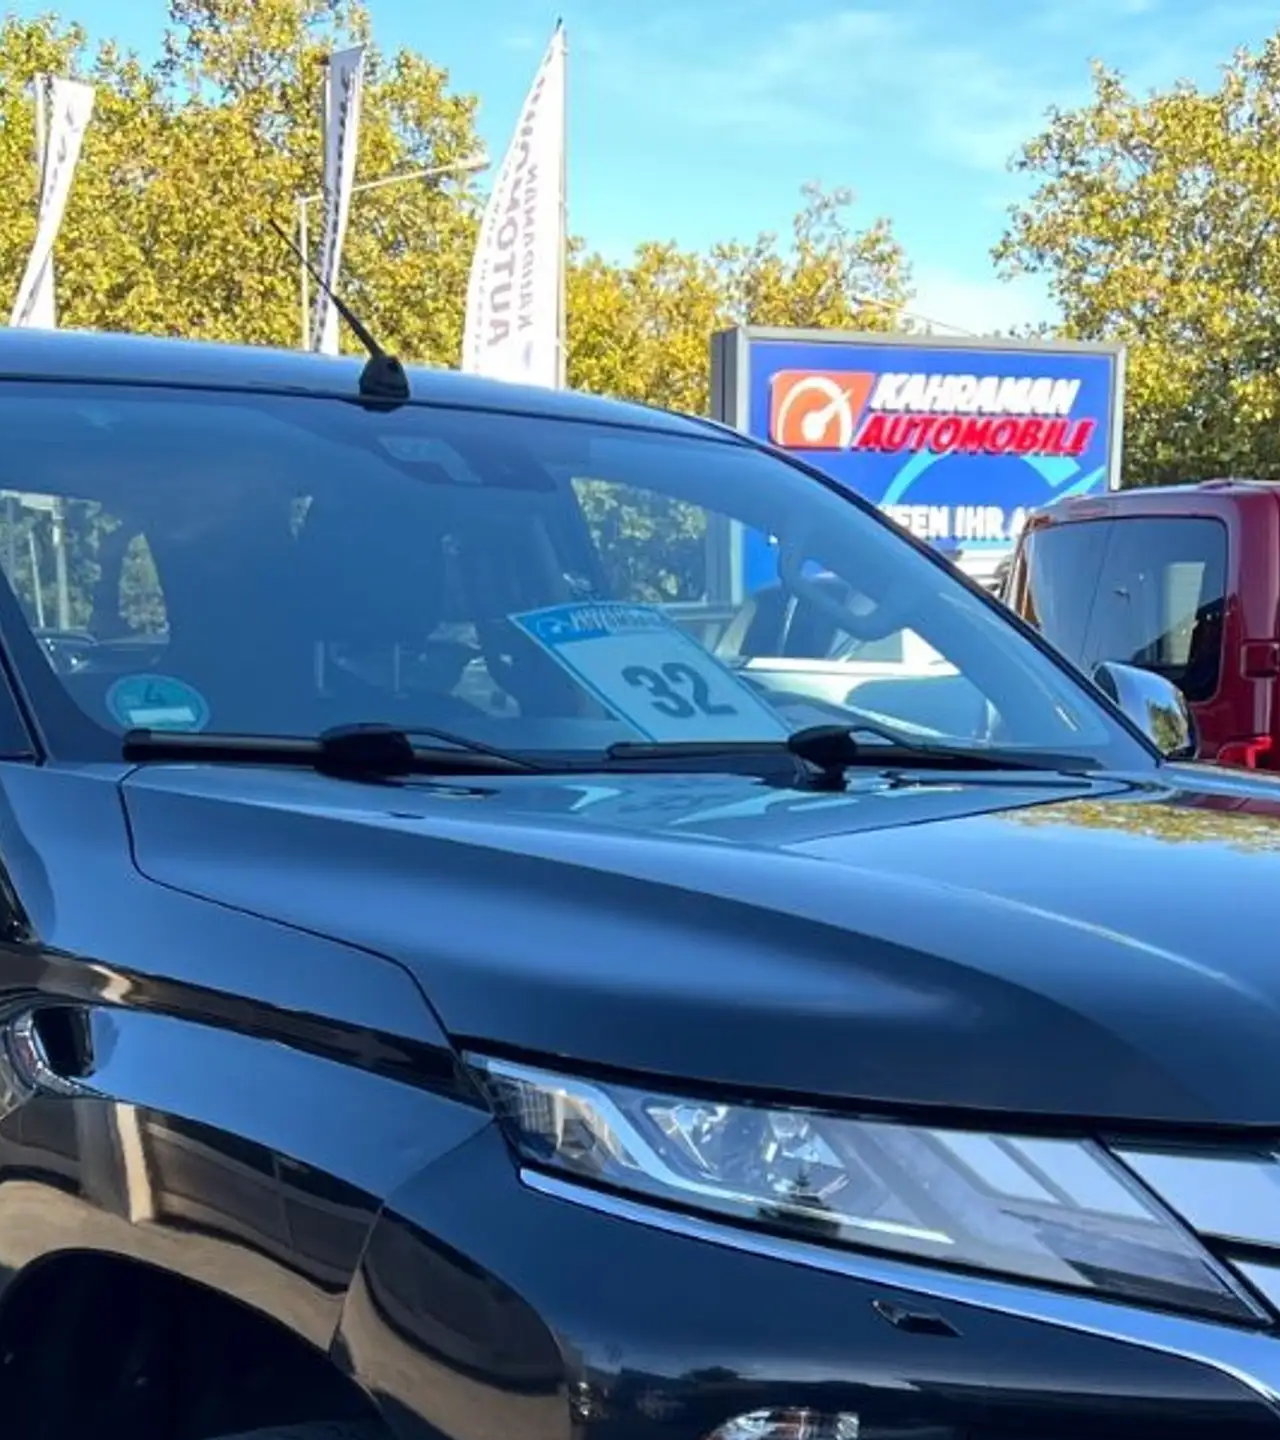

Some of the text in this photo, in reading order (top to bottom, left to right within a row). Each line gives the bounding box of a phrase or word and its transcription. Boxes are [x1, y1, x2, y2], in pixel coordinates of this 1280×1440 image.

[870, 372, 1082, 415] KAHRAMAN
[852, 412, 1098, 456] AUTOMOBILE
[954, 505, 1005, 538] IHR
[621, 661, 738, 719] 32
